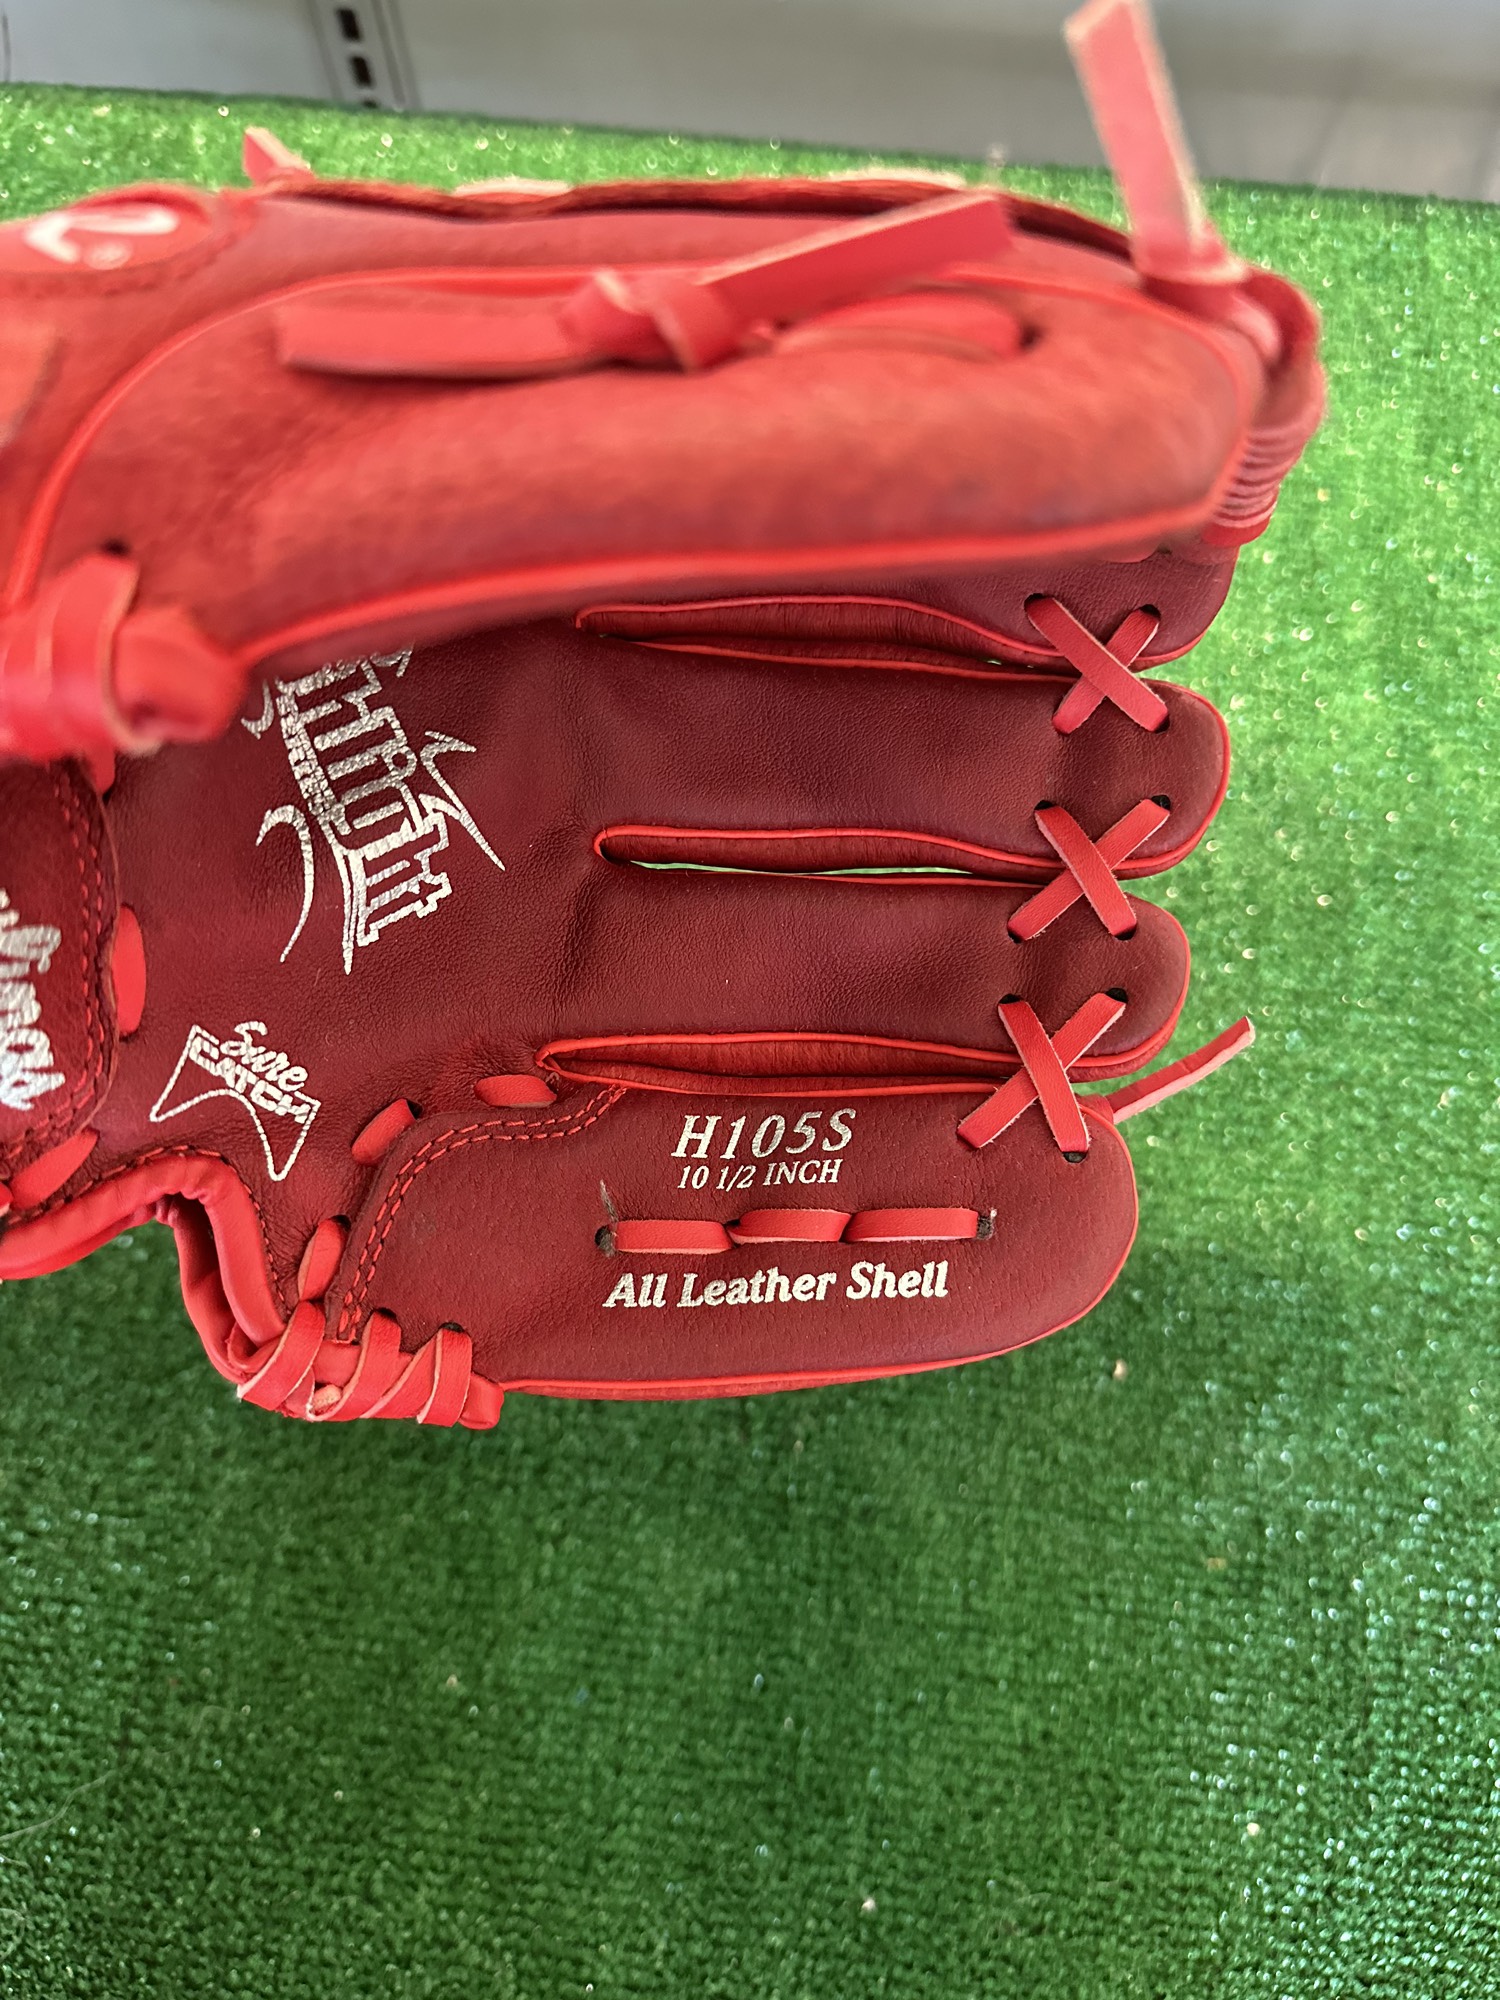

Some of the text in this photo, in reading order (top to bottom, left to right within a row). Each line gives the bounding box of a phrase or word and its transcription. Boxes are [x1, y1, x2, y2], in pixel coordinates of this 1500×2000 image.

[188, 1034, 312, 1124] CATCH
[220, 1021, 309, 1092] Sure
[671, 1108, 857, 1160] H105S
[677, 1159, 842, 1192] 10 1/2 INCH
[602, 1260, 949, 1308] All Leather Shell
